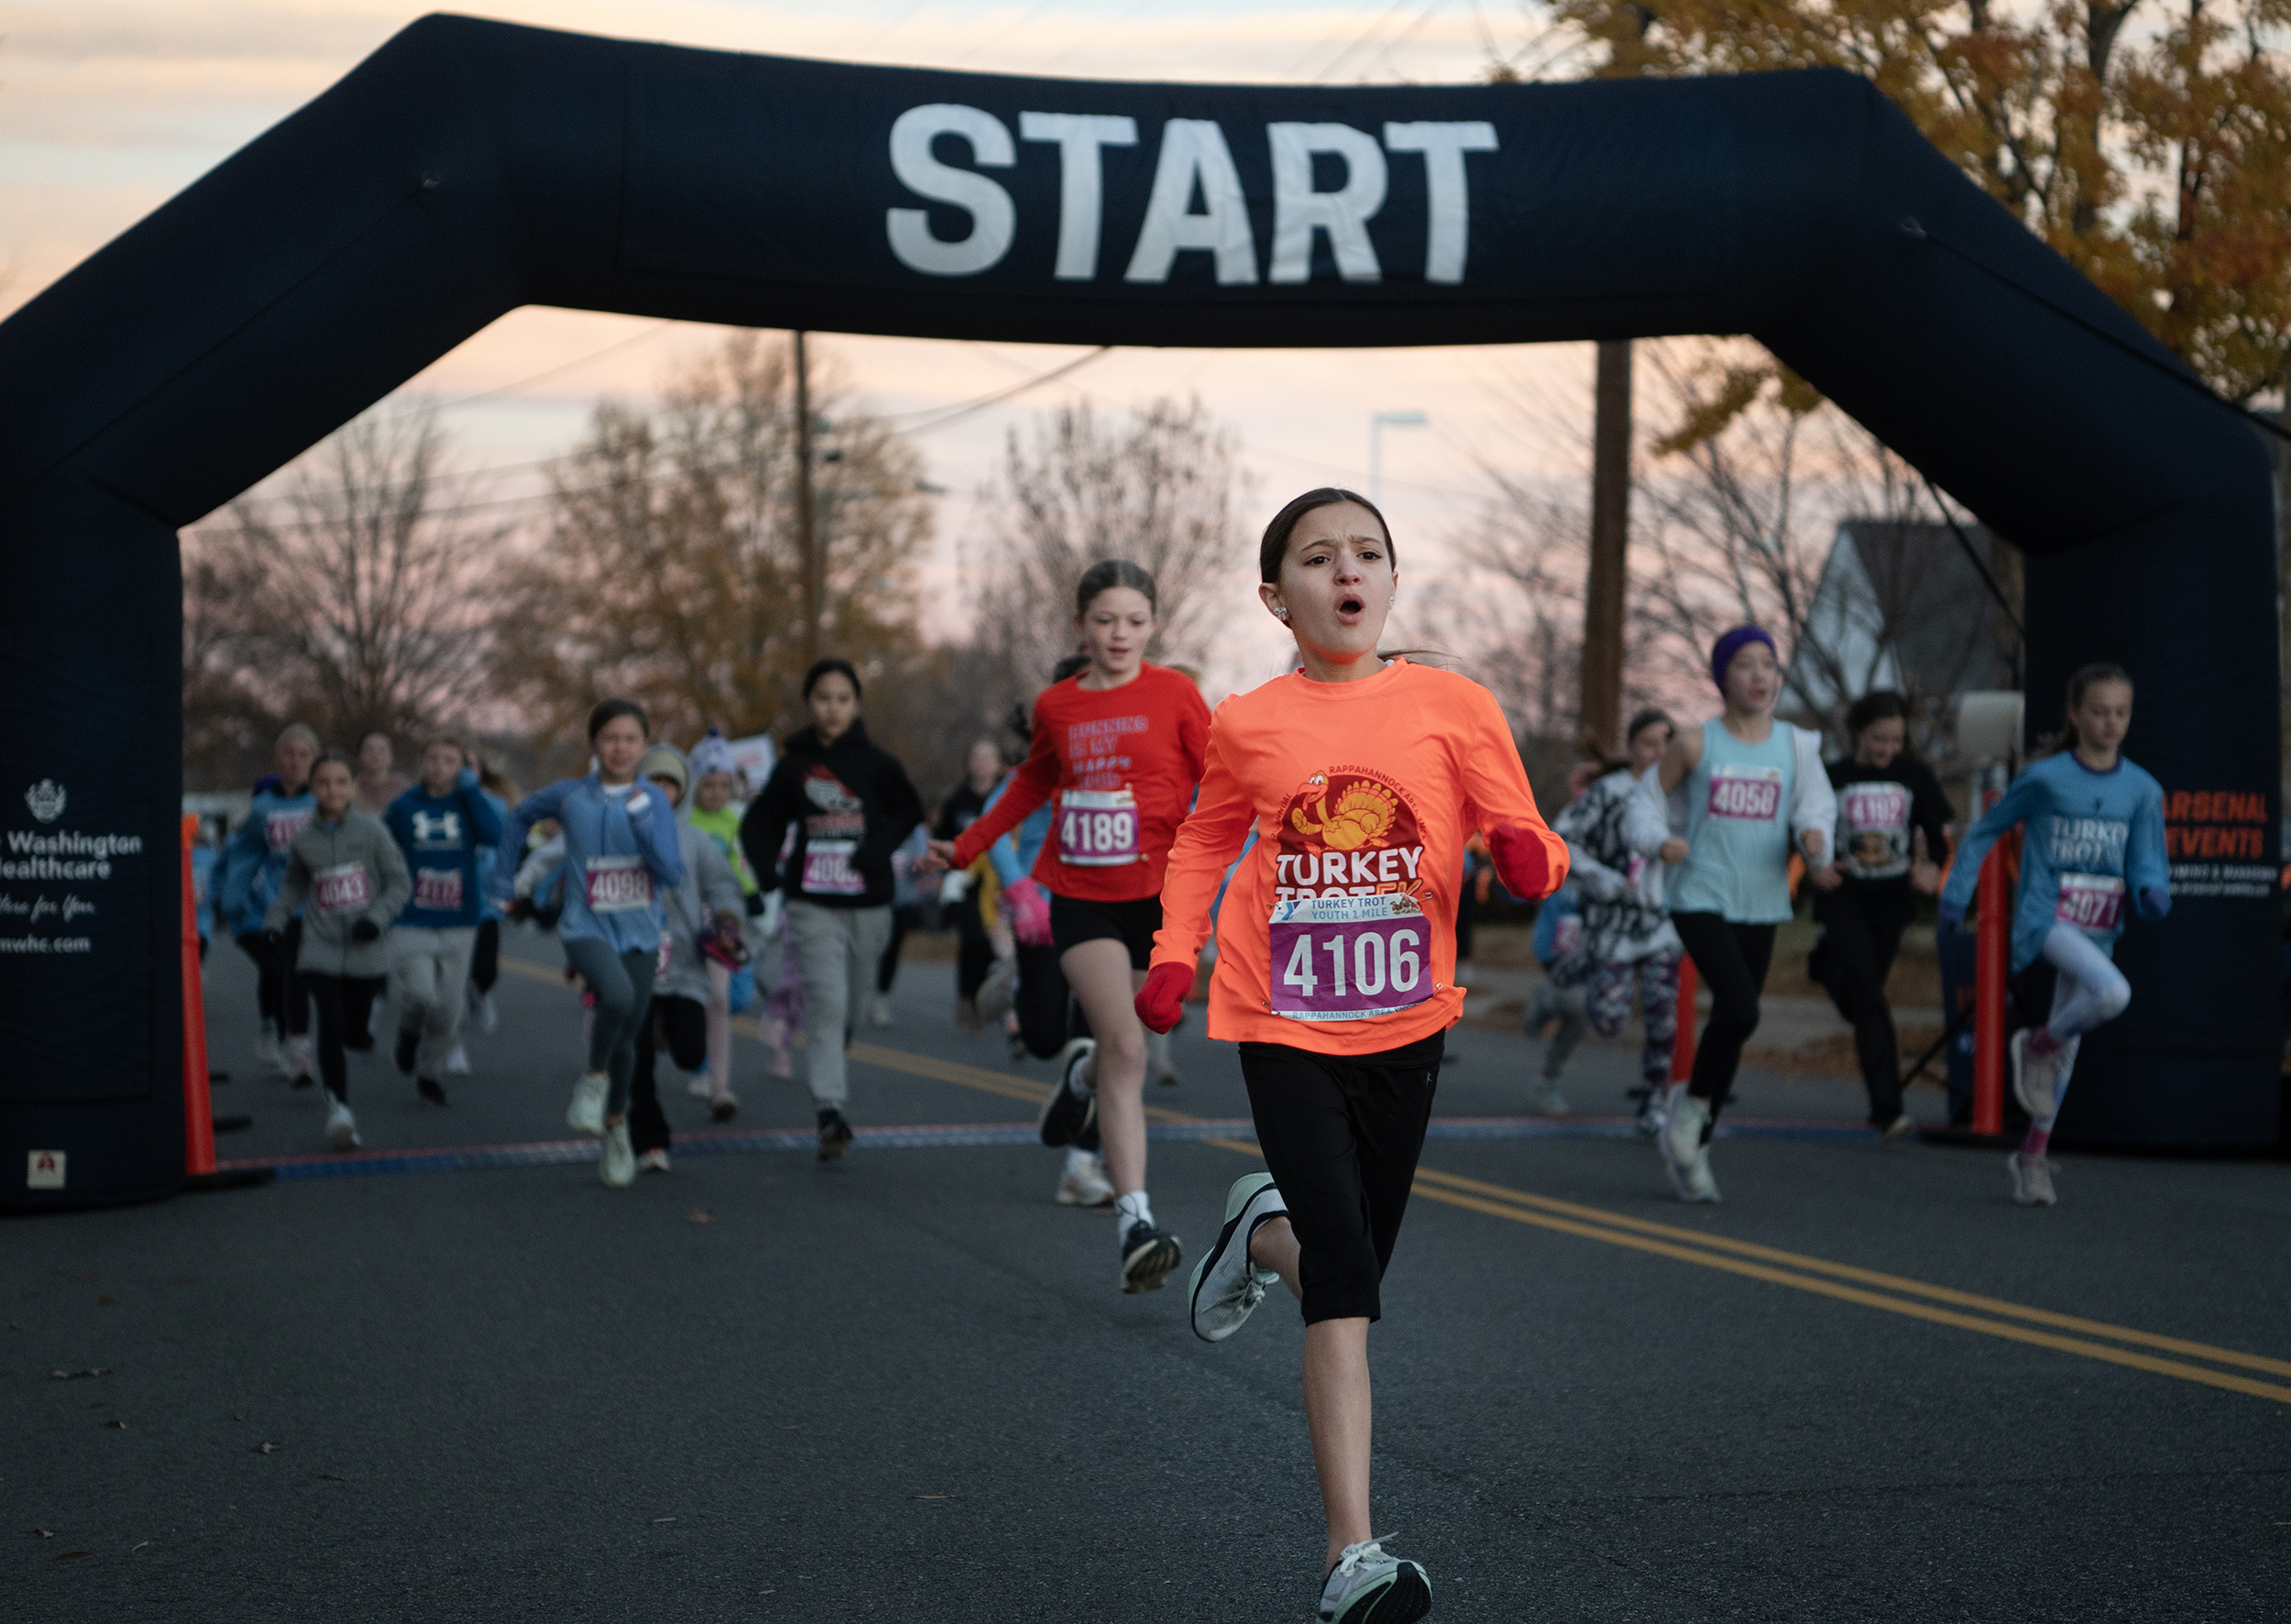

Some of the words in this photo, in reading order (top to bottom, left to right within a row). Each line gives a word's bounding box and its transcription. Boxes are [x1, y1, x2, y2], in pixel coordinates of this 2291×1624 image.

[887, 103, 1499, 284] START
[1069, 715, 1148, 741] RUNNING
[1069, 740, 1086, 759] IS
[1091, 736, 1118, 755] MY
[1073, 756, 1132, 775] HAPPY
[1329, 764, 1406, 795] RAPPAHANNOCK
[1713, 782, 1775, 815] 4058
[7, 829, 142, 860] Washington
[1061, 810, 1134, 852] 4189
[1277, 846, 1424, 886] TURKEY
[591, 872, 650, 903] 4098
[1311, 899, 1354, 909] TURKEY
[1358, 896, 1386, 907] TROT
[1311, 910, 1349, 920] YOUTH
[1353, 909, 1359, 919] 1
[1362, 907, 1388, 917] MILE
[1283, 928, 1420, 996] 4106
[1292, 1010, 1366, 1020] RAPPAHANNOCK
